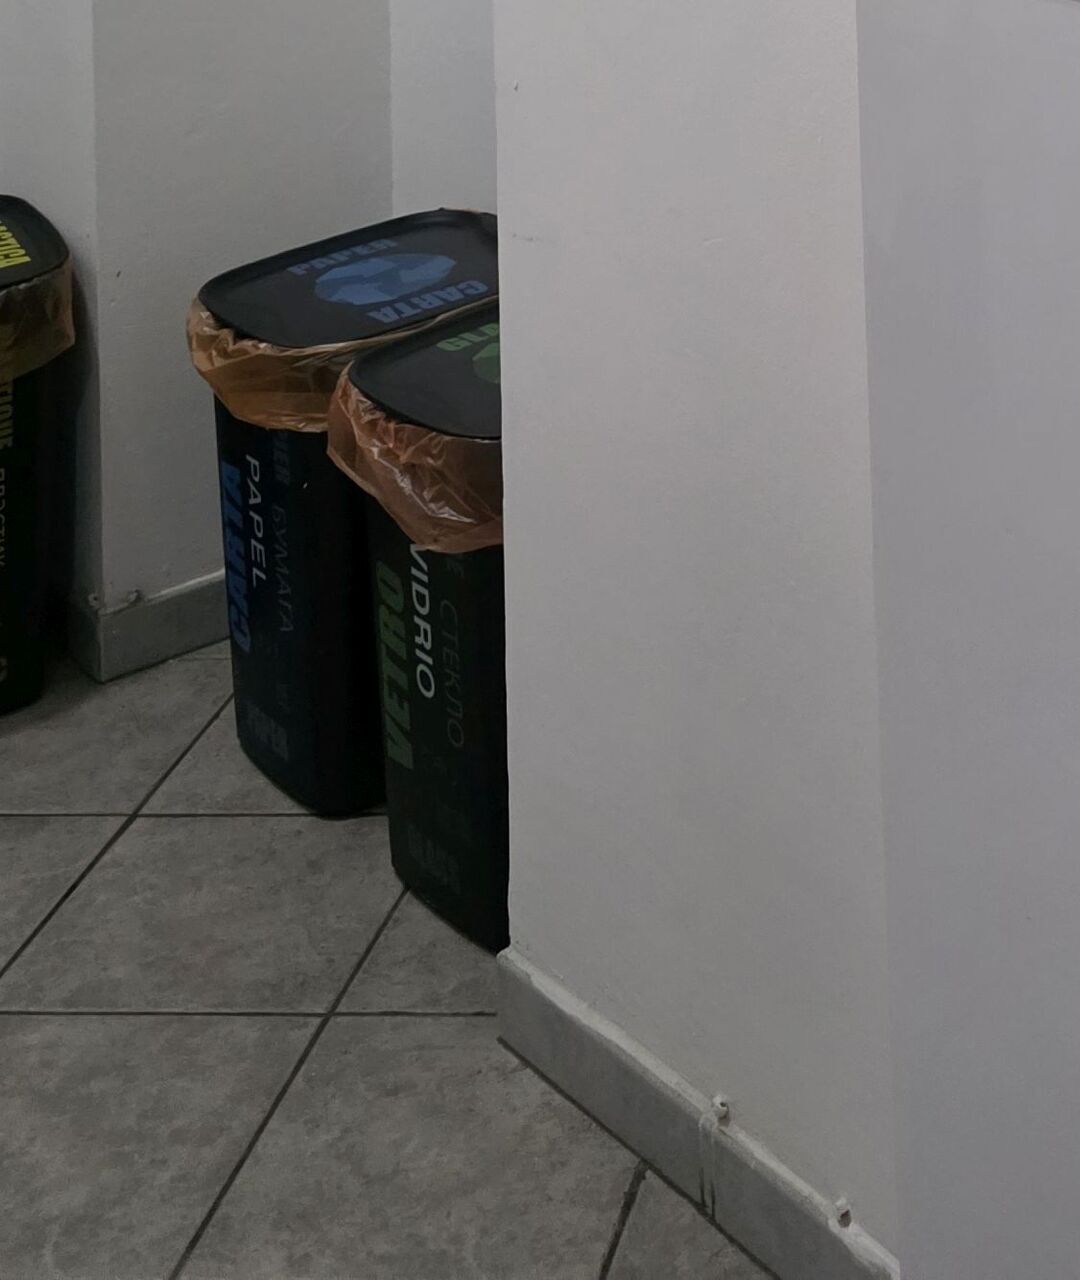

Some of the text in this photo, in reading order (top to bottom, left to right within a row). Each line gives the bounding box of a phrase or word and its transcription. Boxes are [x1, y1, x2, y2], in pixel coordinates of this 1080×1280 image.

[287, 239, 398, 275] PAPER
[366, 280, 488, 323] CARTA
[221, 461, 252, 655] CARTA
[246, 454, 267, 588] PAPEL
[376, 560, 414, 770] VETRO
[410, 543, 435, 699] VIDRIO
